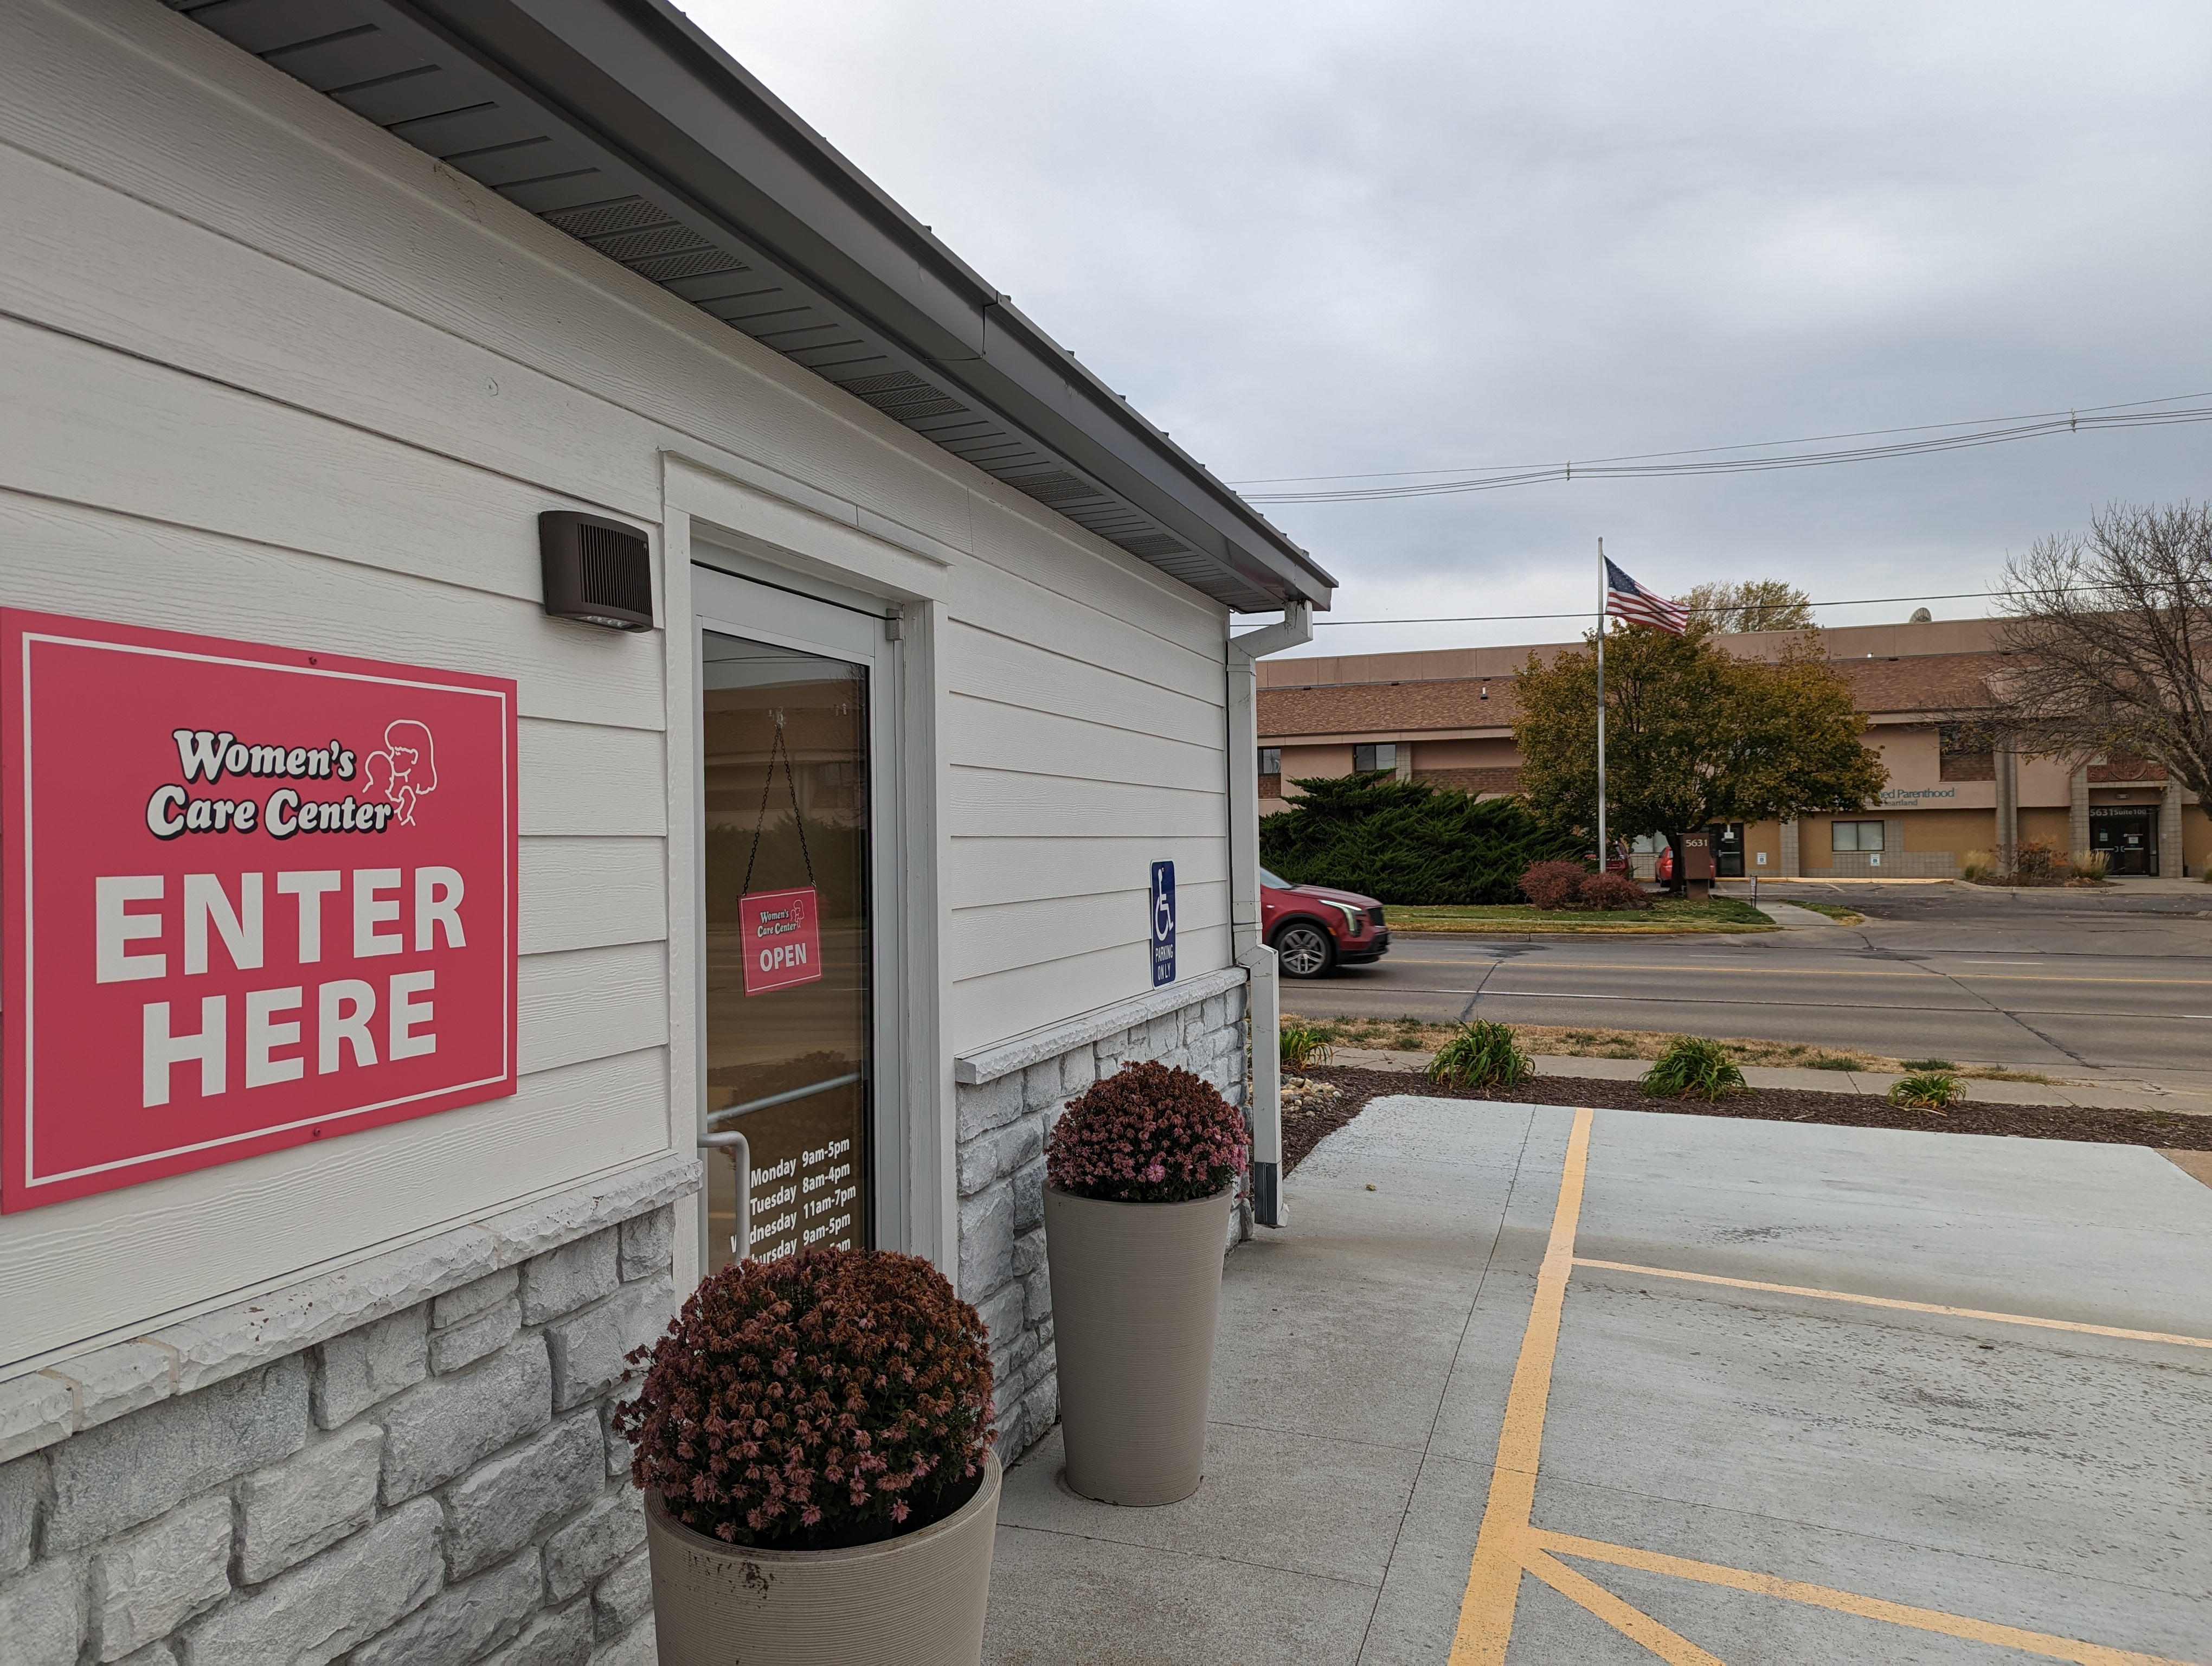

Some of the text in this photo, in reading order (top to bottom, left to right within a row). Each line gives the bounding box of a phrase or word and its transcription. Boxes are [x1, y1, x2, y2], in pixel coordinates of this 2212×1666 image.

[174, 729, 357, 781] Women's
[1897, 787, 1954, 799] Parenthood
[146, 785, 394, 840] Care Center
[1686, 839, 1708, 847] 5631
[95, 866, 466, 984] ENTER
[757, 922, 796, 938] Care Center
[760, 909, 789, 924] Women's
[760, 943, 807, 972] OPEN
[1155, 944, 1173, 963] PARKING
[1158, 962, 1171, 981] ONLY
[143, 970, 436, 1108] HERE
[751, 1138, 850, 1188] Monday 9am-5pm
[750, 1163, 850, 1215] Tuesday 8am-4pm
[803, 1186, 856, 1219] 11am-7pm
[750, 1238, 797, 1265] hursday
[803, 1213, 851, 1246] 9am-5pm
